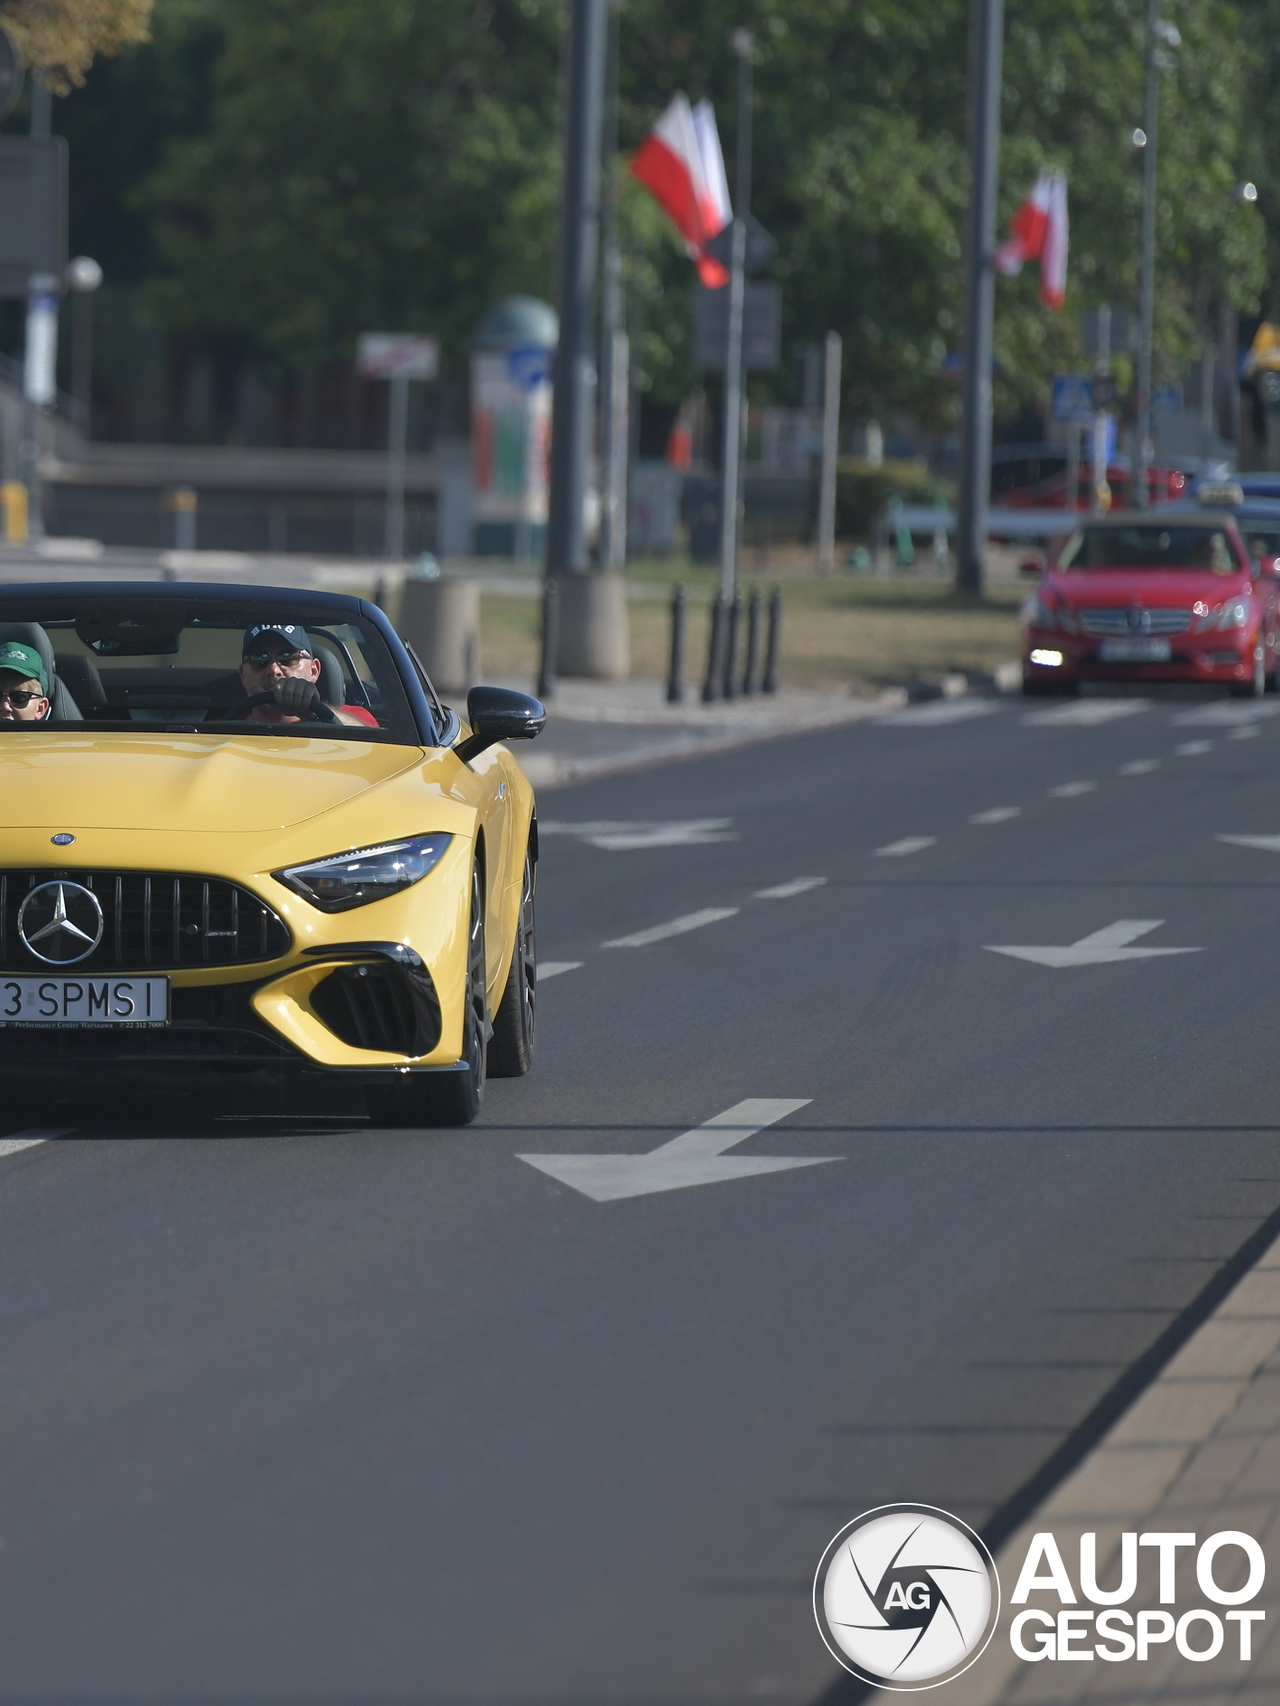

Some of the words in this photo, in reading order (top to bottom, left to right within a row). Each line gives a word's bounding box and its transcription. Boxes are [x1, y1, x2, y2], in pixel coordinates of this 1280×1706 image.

[15, 1021, 55, 1029] Performance
[57, 1021, 79, 1029] Center
[81, 1021, 113, 1029] Warszawa
